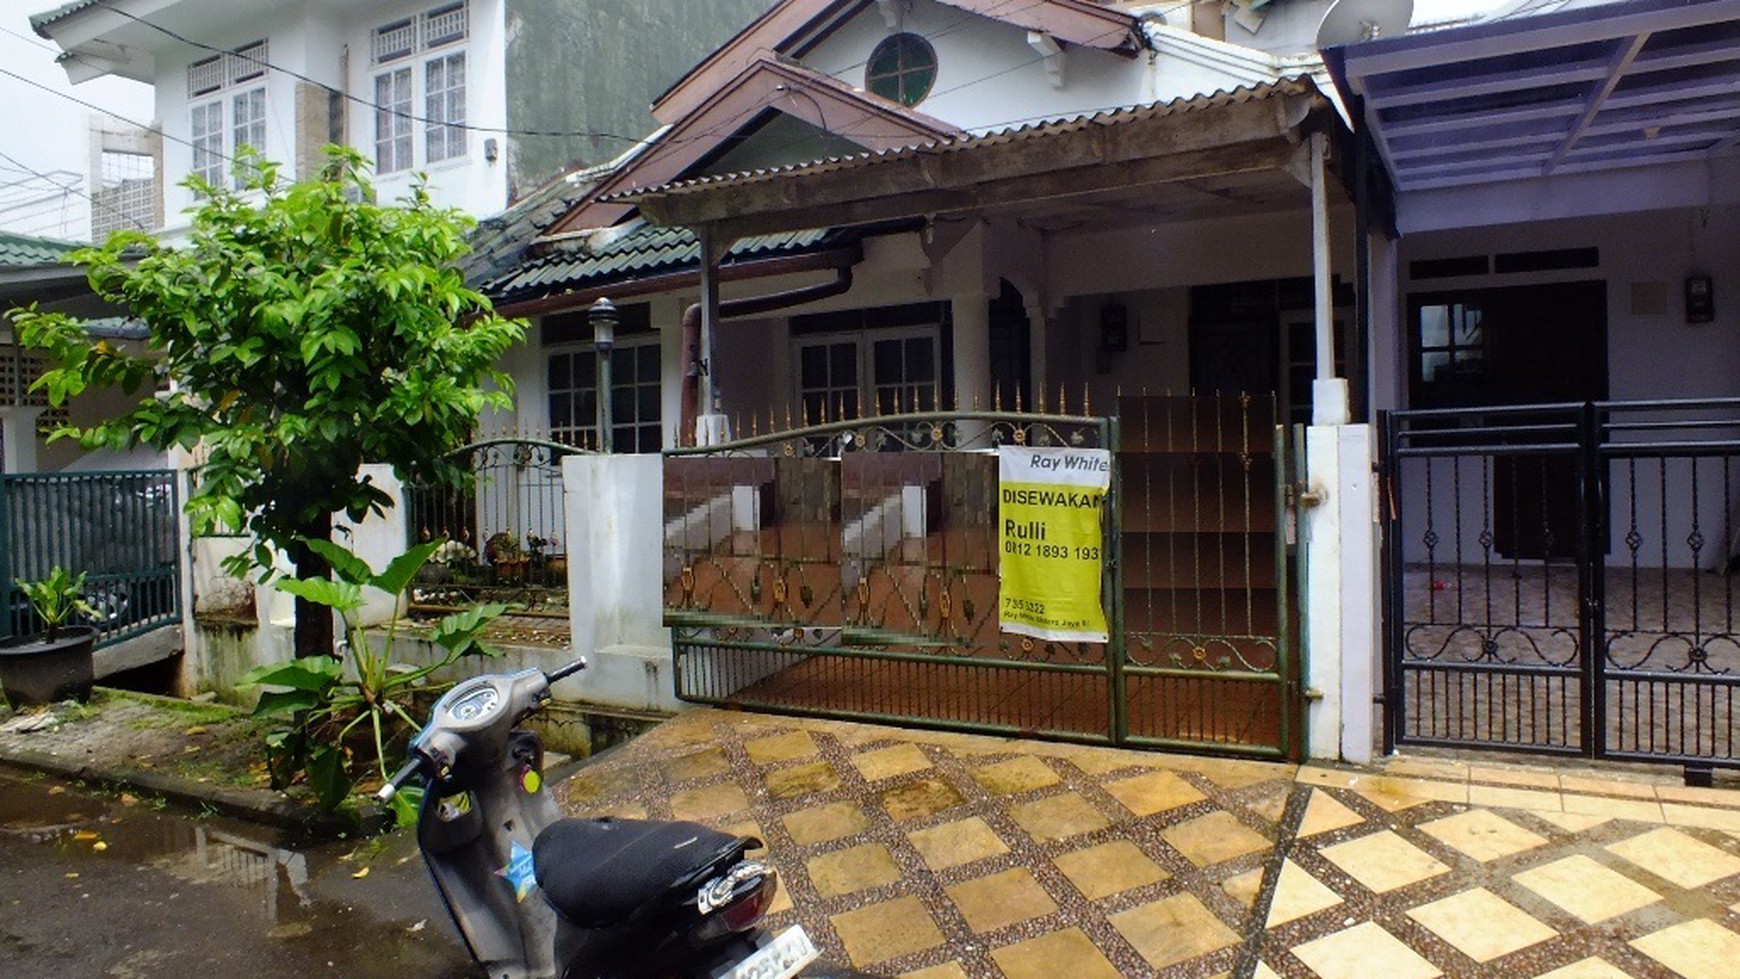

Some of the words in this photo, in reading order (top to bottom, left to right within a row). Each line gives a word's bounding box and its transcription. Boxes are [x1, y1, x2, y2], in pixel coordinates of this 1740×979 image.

[1030, 454, 1061, 471] Ray
[1064, 455, 1108, 472] White
[1005, 519, 1046, 540] Rulli
[1036, 544, 1069, 559] 1893
[1074, 546, 1101, 561] 193
